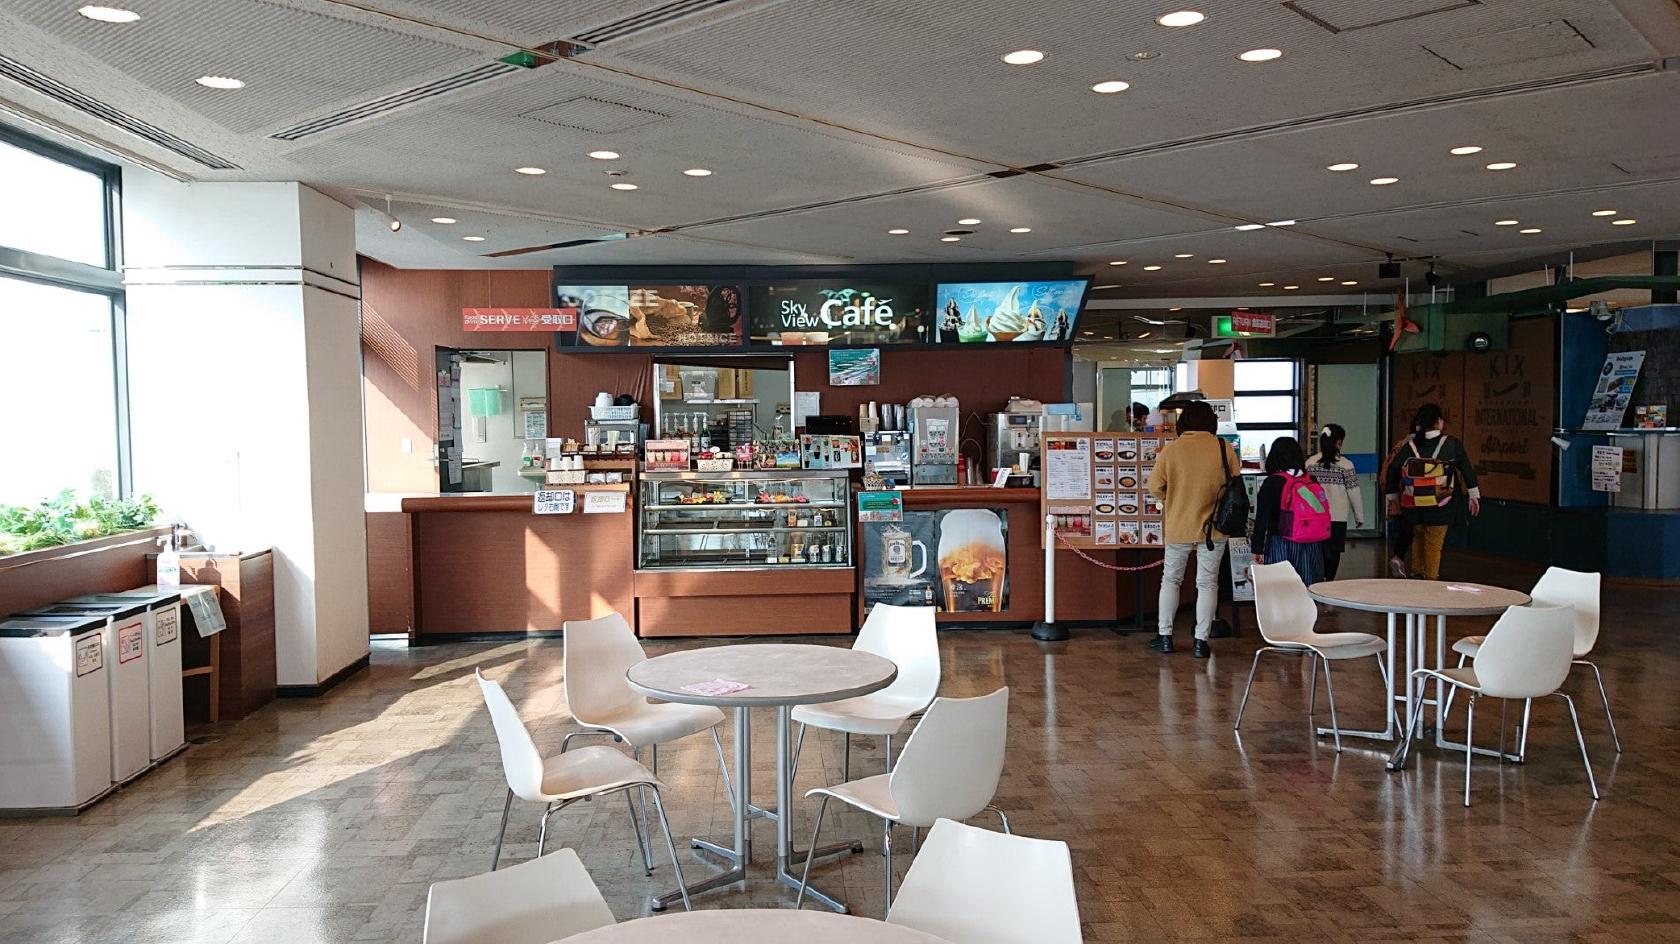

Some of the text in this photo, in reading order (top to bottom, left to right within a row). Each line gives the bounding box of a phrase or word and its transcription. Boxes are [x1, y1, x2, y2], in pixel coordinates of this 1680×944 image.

[781, 300, 807, 315] Sky
[820, 297, 894, 327] Café
[480, 314, 520, 325] SERVE
[541, 314, 573, 325] 受取口
[781, 314, 819, 328] View
[1412, 358, 1442, 382] KIX
[1489, 354, 1527, 379] KIX
[1475, 408, 1539, 427] INTERNATIONAL
[537, 491, 571, 503] 返却口は
